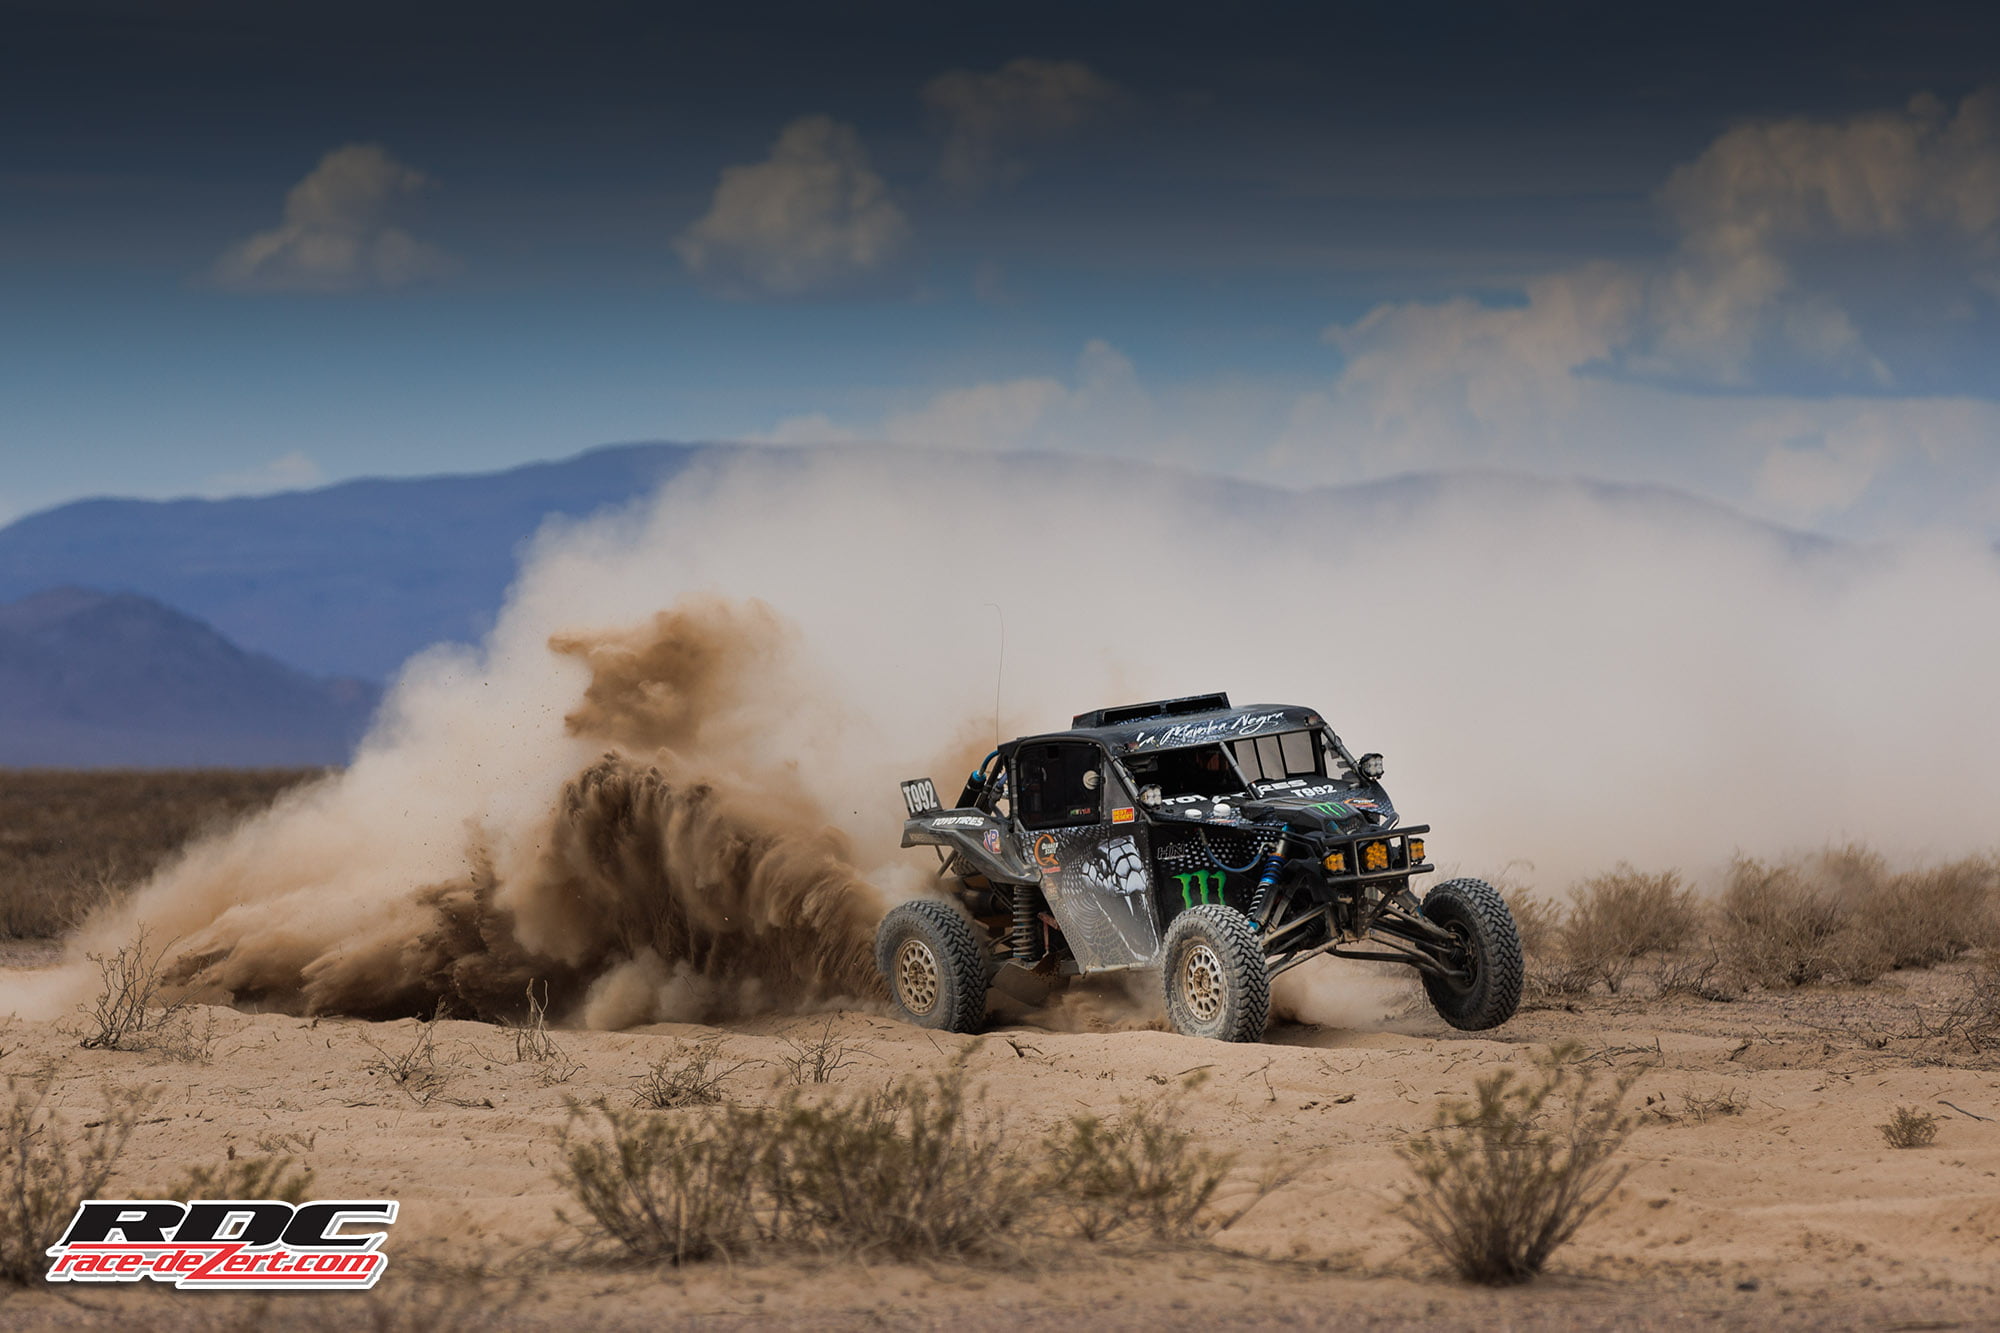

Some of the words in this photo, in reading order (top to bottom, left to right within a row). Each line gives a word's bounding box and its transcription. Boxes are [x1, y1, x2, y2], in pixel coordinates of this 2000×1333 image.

[1231, 712, 1284, 735] Negra
[902, 780, 937, 813] T992
[1291, 784, 1337, 797] T992
